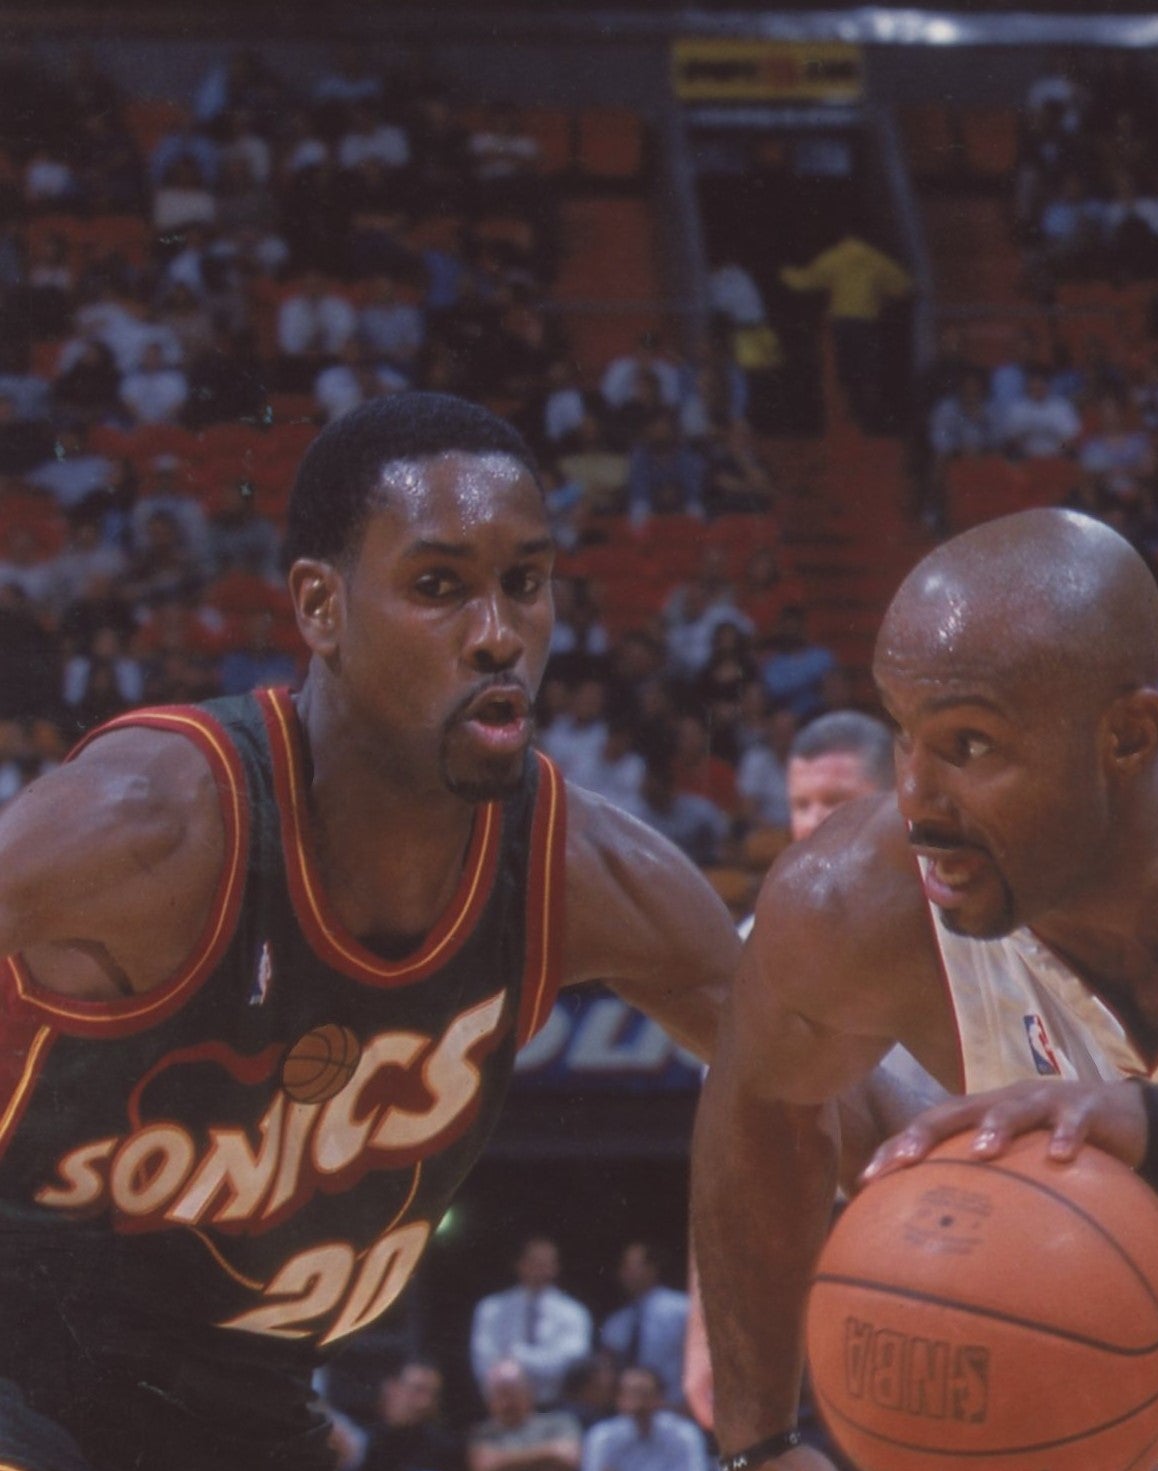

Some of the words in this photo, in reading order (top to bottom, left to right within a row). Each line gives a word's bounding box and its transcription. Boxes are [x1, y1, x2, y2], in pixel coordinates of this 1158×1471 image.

[34, 987, 507, 1224] SONICS
[212, 1220, 431, 1348] 20
[844, 1314, 951, 1420] NBA
